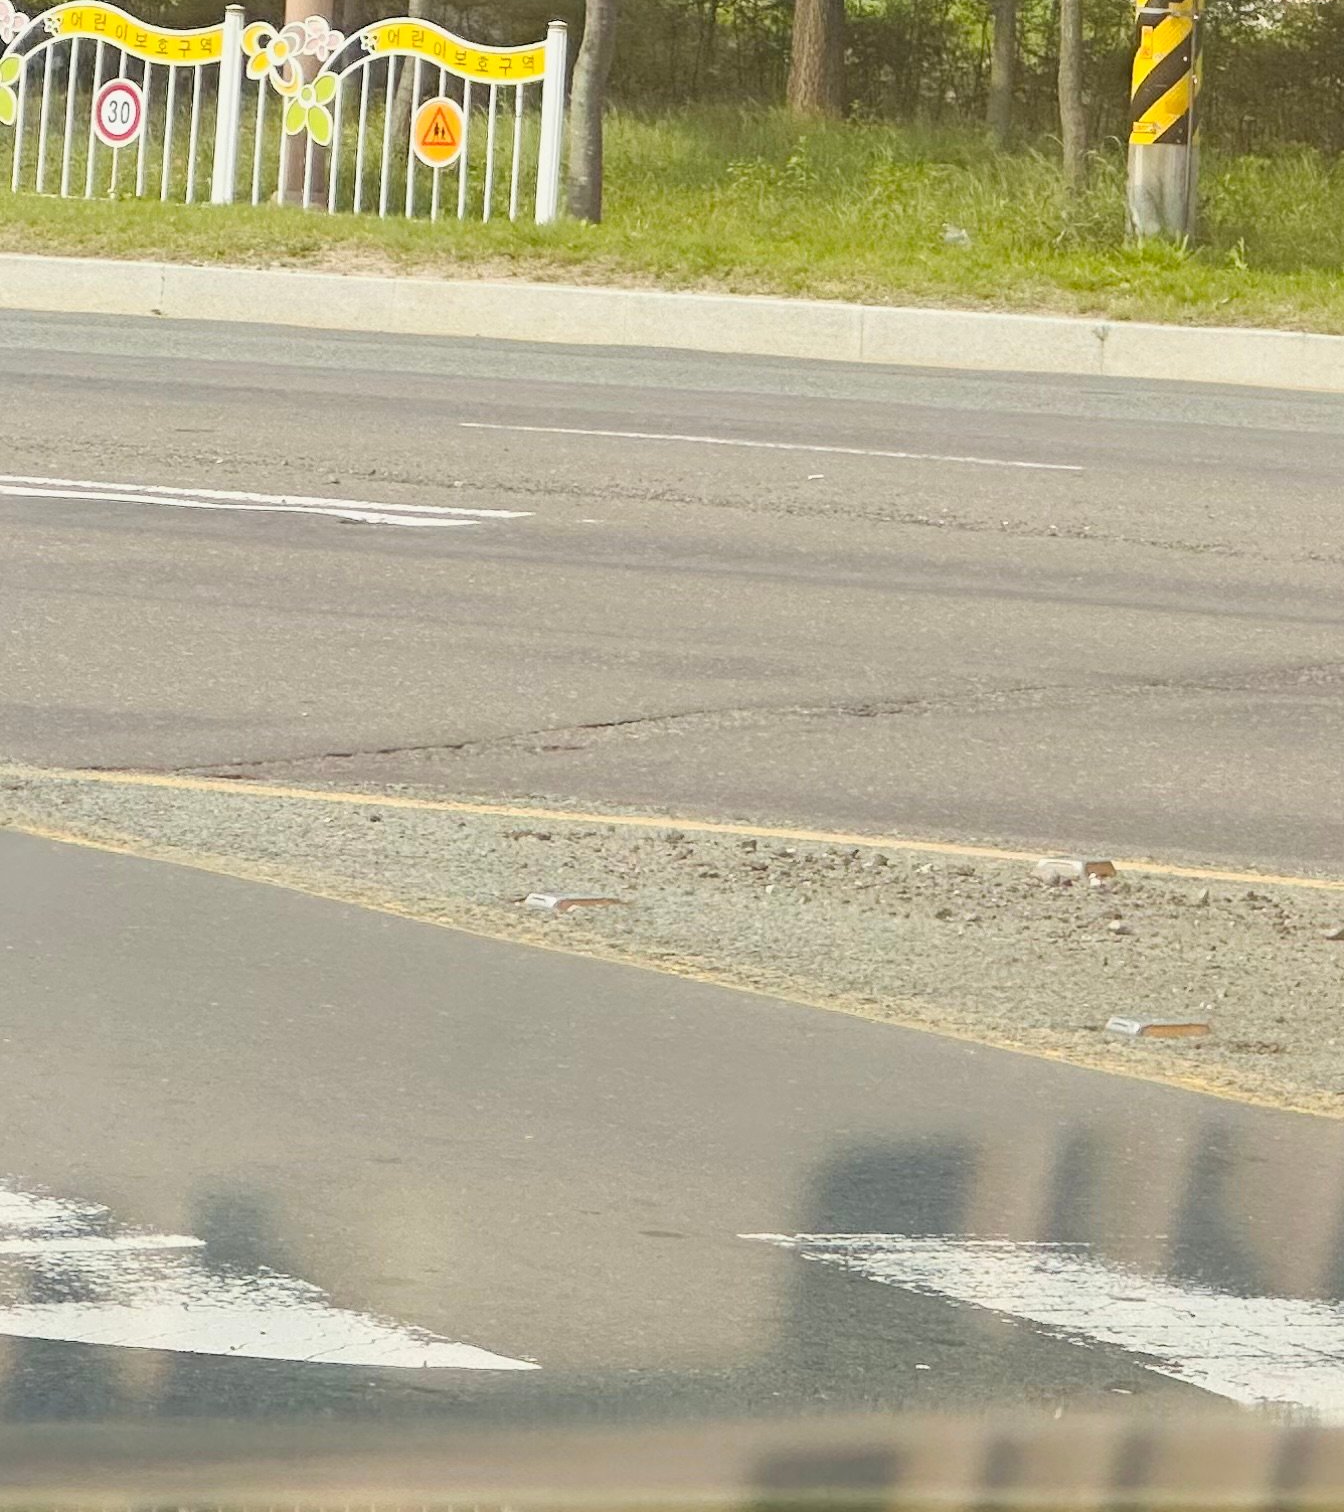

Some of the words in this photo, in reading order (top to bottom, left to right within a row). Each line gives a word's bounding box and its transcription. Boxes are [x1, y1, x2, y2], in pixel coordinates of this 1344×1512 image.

[71, 12, 213, 57] 어린이보호구역
[387, 28, 535, 75] 어린이보호구역
[108, 100, 131, 124] 30
